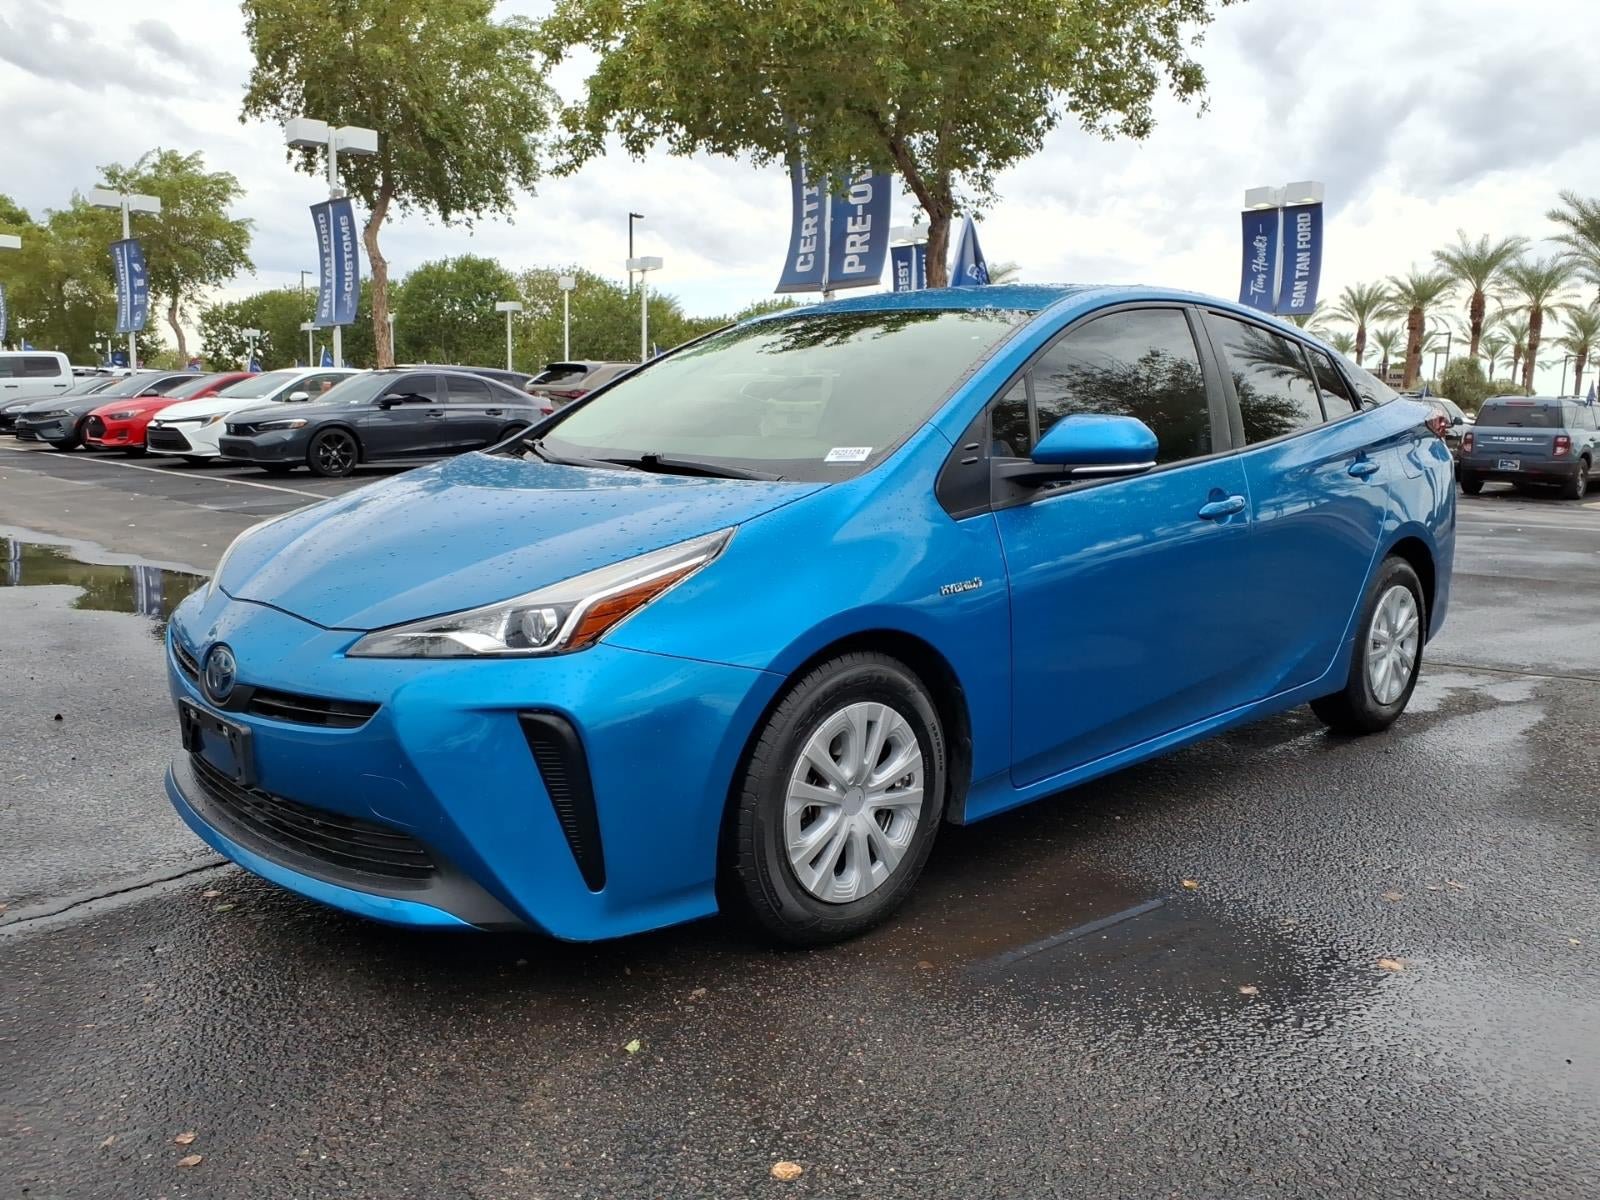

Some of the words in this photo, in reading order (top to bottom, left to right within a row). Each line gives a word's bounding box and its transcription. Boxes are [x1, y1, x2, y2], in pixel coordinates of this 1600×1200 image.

[318, 213, 330, 253] FORD
[1297, 212, 1311, 249] FORD
[340, 215, 354, 292] CUSTOMS
[1252, 235, 1269, 273] Hovik's
[1295, 252, 1311, 279] TAN
[115, 247, 127, 293] PARTNER
[324, 257, 332, 287] TAN
[1250, 274, 1267, 296] Tim
[321, 289, 331, 319] SAN
[1290, 281, 1308, 308] SAN
[940, 577, 983, 595] HYBRID
